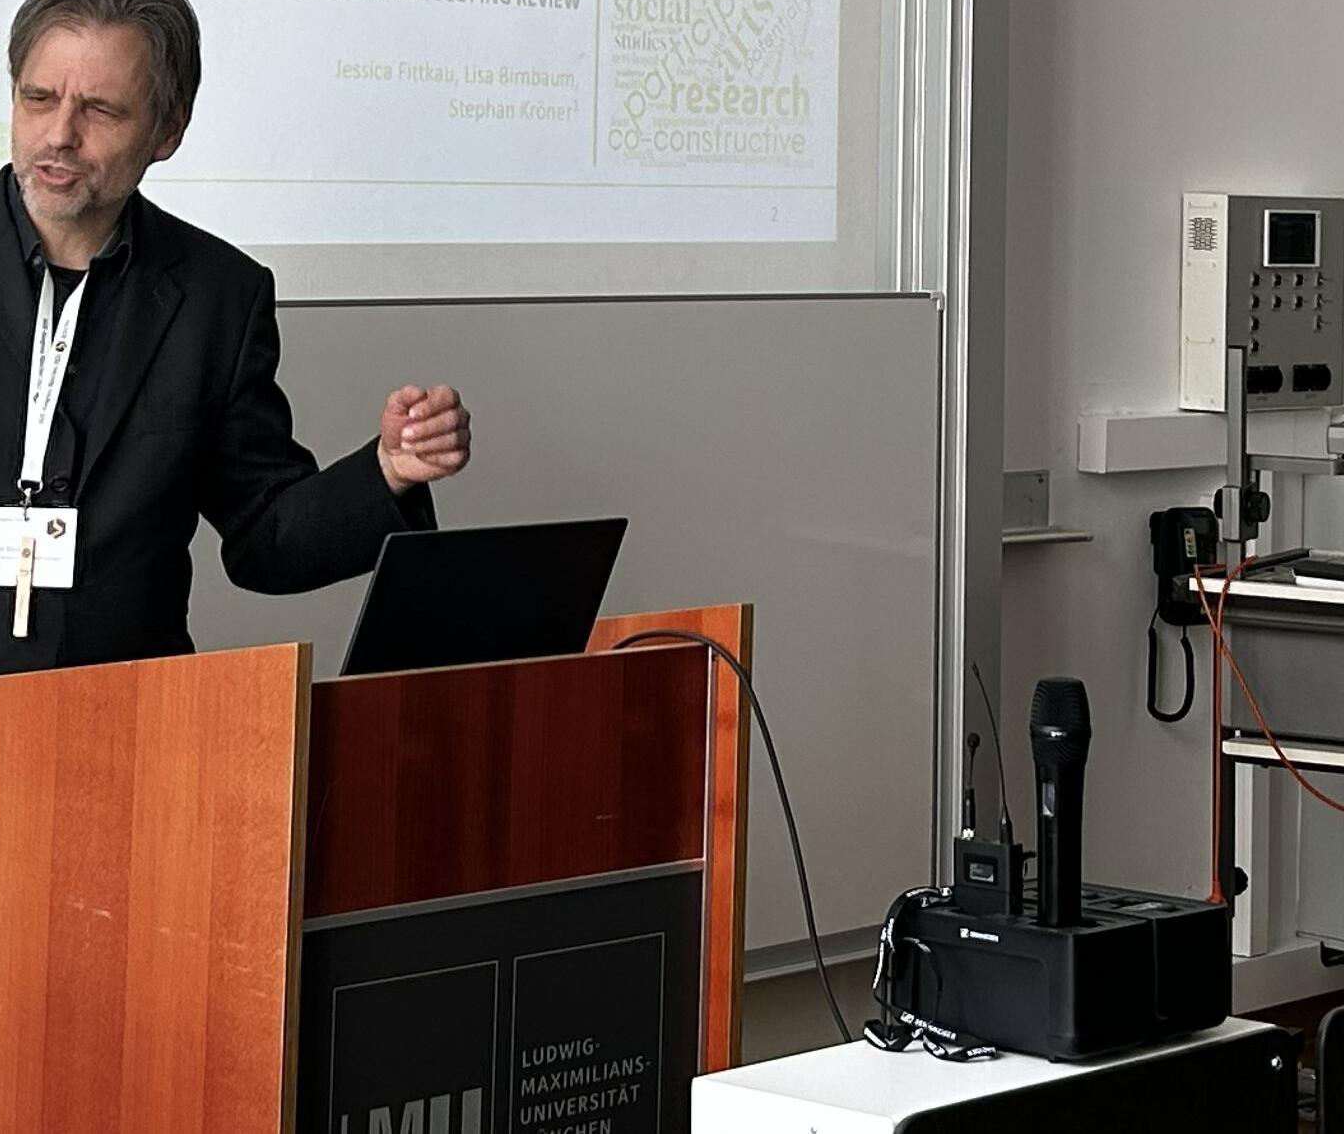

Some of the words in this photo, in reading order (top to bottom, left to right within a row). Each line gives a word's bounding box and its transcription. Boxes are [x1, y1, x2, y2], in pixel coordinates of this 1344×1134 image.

[448, 99, 516, 126] Stephan
[671, 73, 811, 117] research
[522, 1037, 601, 1069] LUDWIG-
[520, 1055, 651, 1098] MAXIMILIANS-
[520, 1083, 641, 1126] UNIVERSITÄT
